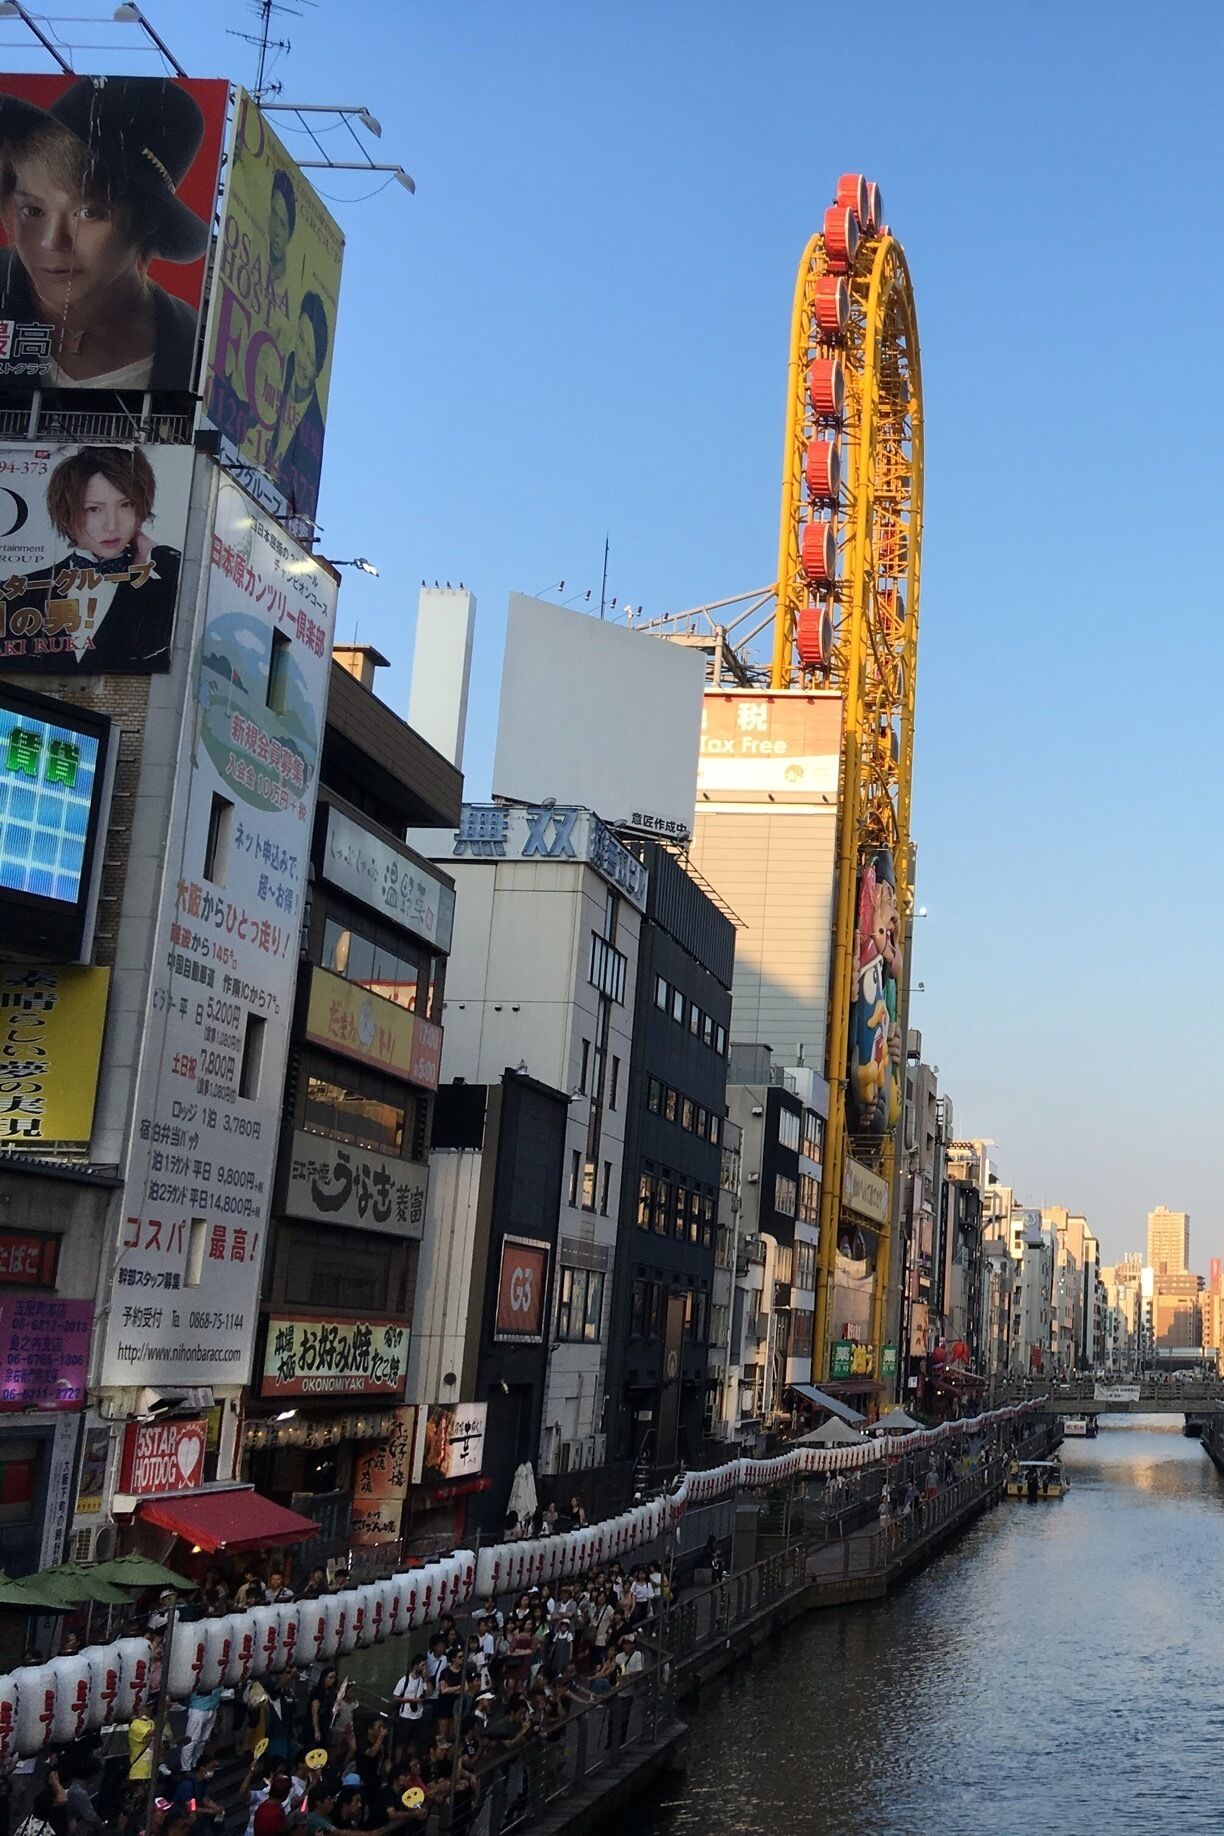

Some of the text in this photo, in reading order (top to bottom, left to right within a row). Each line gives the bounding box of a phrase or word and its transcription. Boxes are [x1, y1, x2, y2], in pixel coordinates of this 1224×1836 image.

[700, 735, 787, 754] Tax Free
[223, 1114, 262, 1140] 3,780円
[311, 1150, 397, 1224] うなぎ
[123, 1216, 260, 1264] コスパ 最高!
[510, 1266, 534, 1313] G3
[189, 1311, 244, 1330] 0868-75-1144
[117, 1341, 242, 1366] http://www.nihonbaracc.com
[298, 1322, 373, 1373] お好み焼
[276, 1353, 297, 1386] 大阪
[301, 1376, 365, 1394] OKONOMIYAKI
[133, 1454, 177, 1488] HOTDOG
